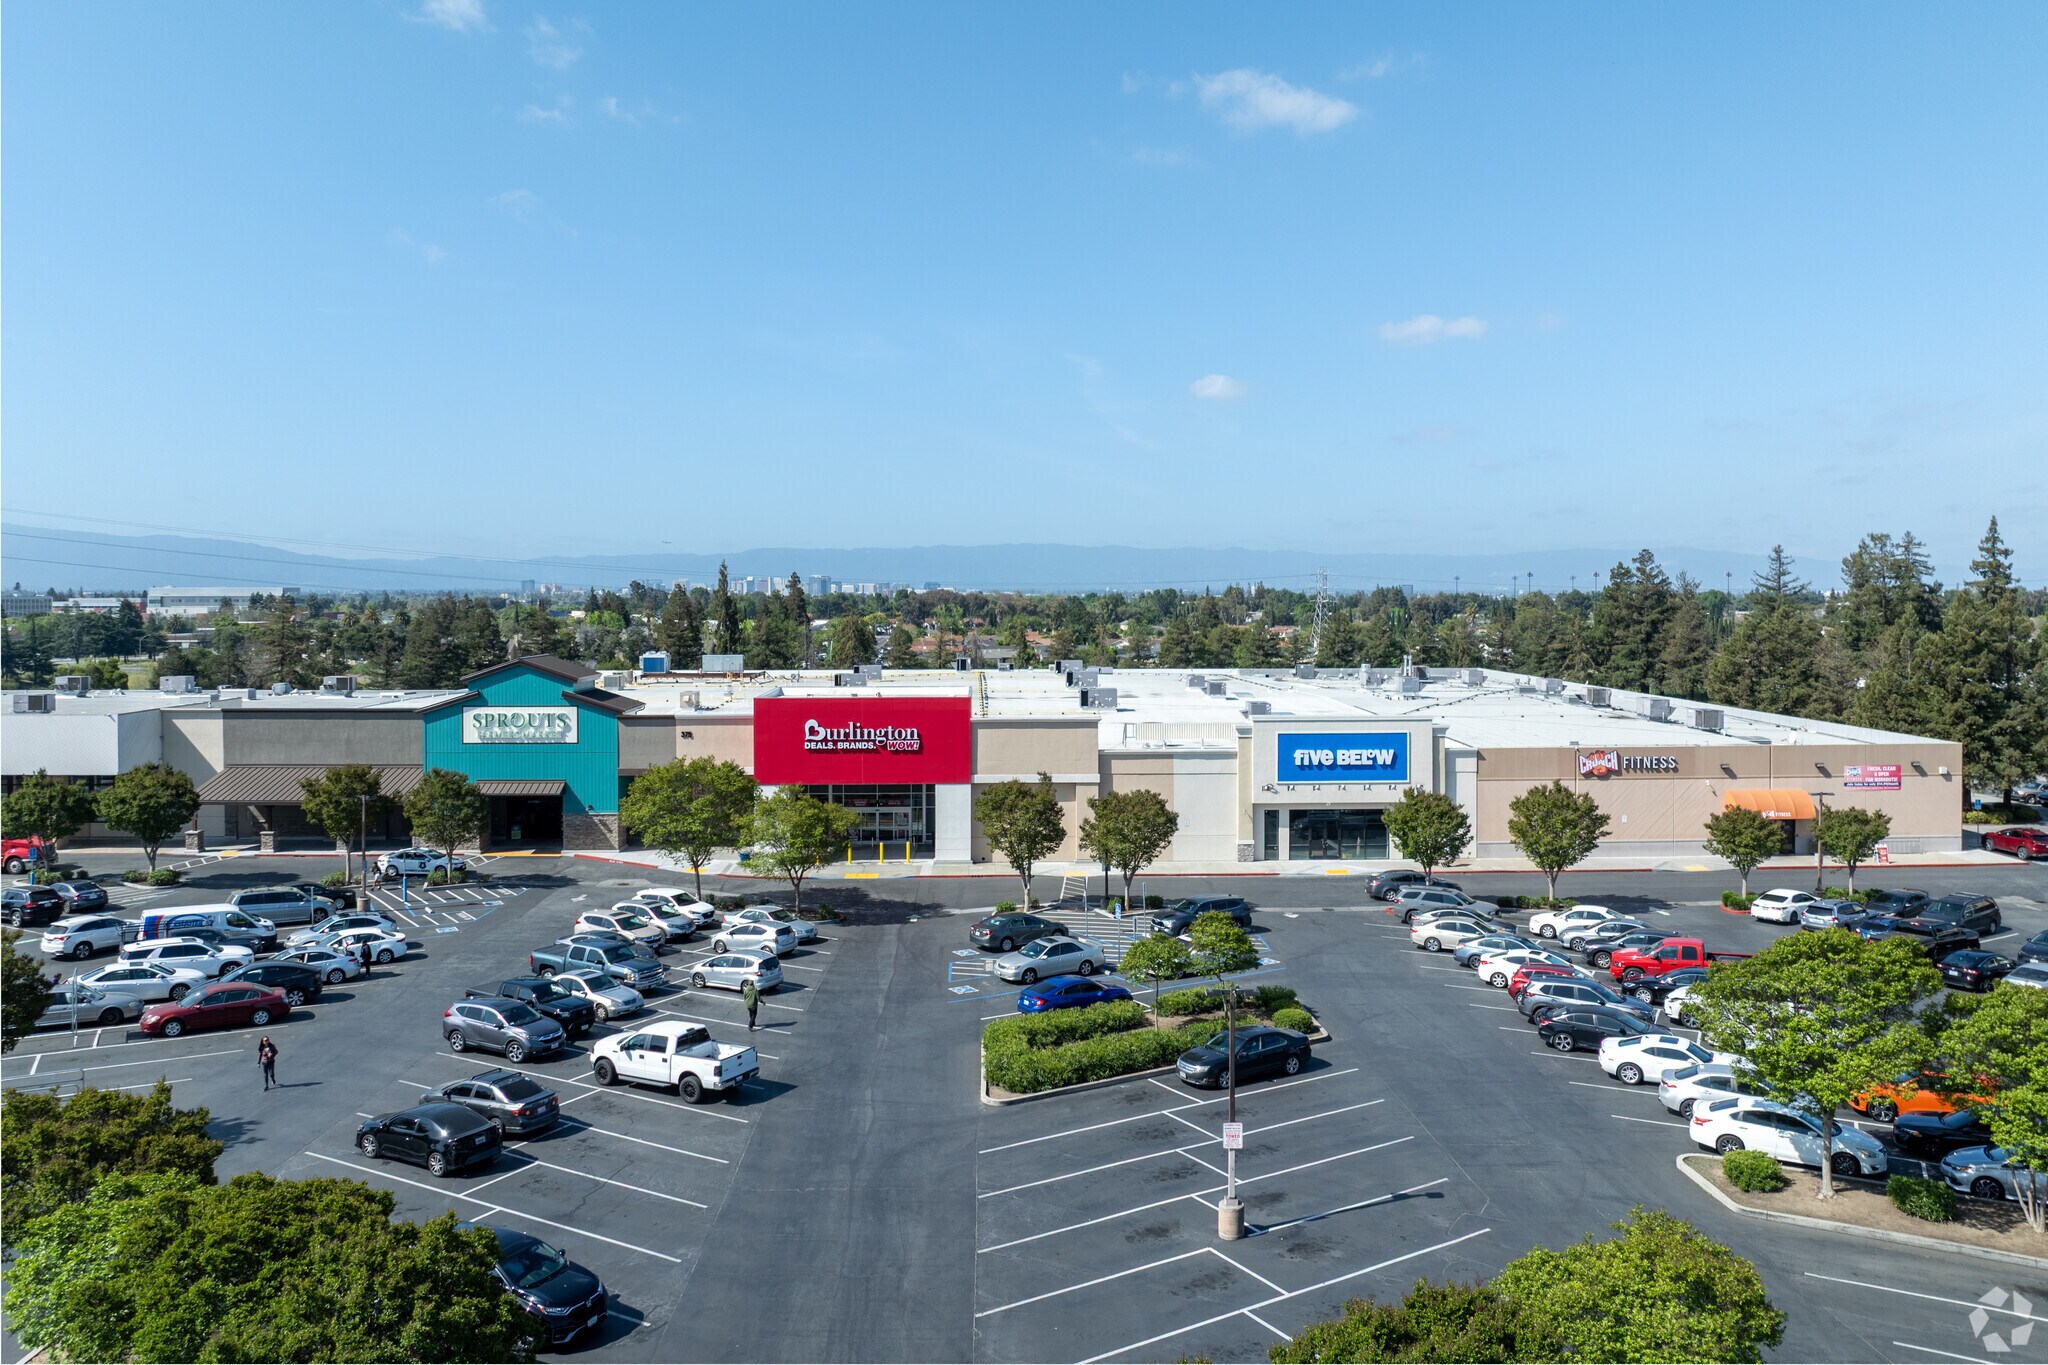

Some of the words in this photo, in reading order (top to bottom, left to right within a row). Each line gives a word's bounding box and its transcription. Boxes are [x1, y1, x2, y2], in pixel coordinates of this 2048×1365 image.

[473, 712, 568, 728] SPROUTS
[479, 730, 522, 739] FARMERS
[523, 730, 563, 739] MARKET
[804, 719, 919, 746] Burlington
[887, 740, 920, 751] WOW!
[1579, 751, 1619, 774] CRUNCH
[1623, 756, 1676, 769] FITNESS
